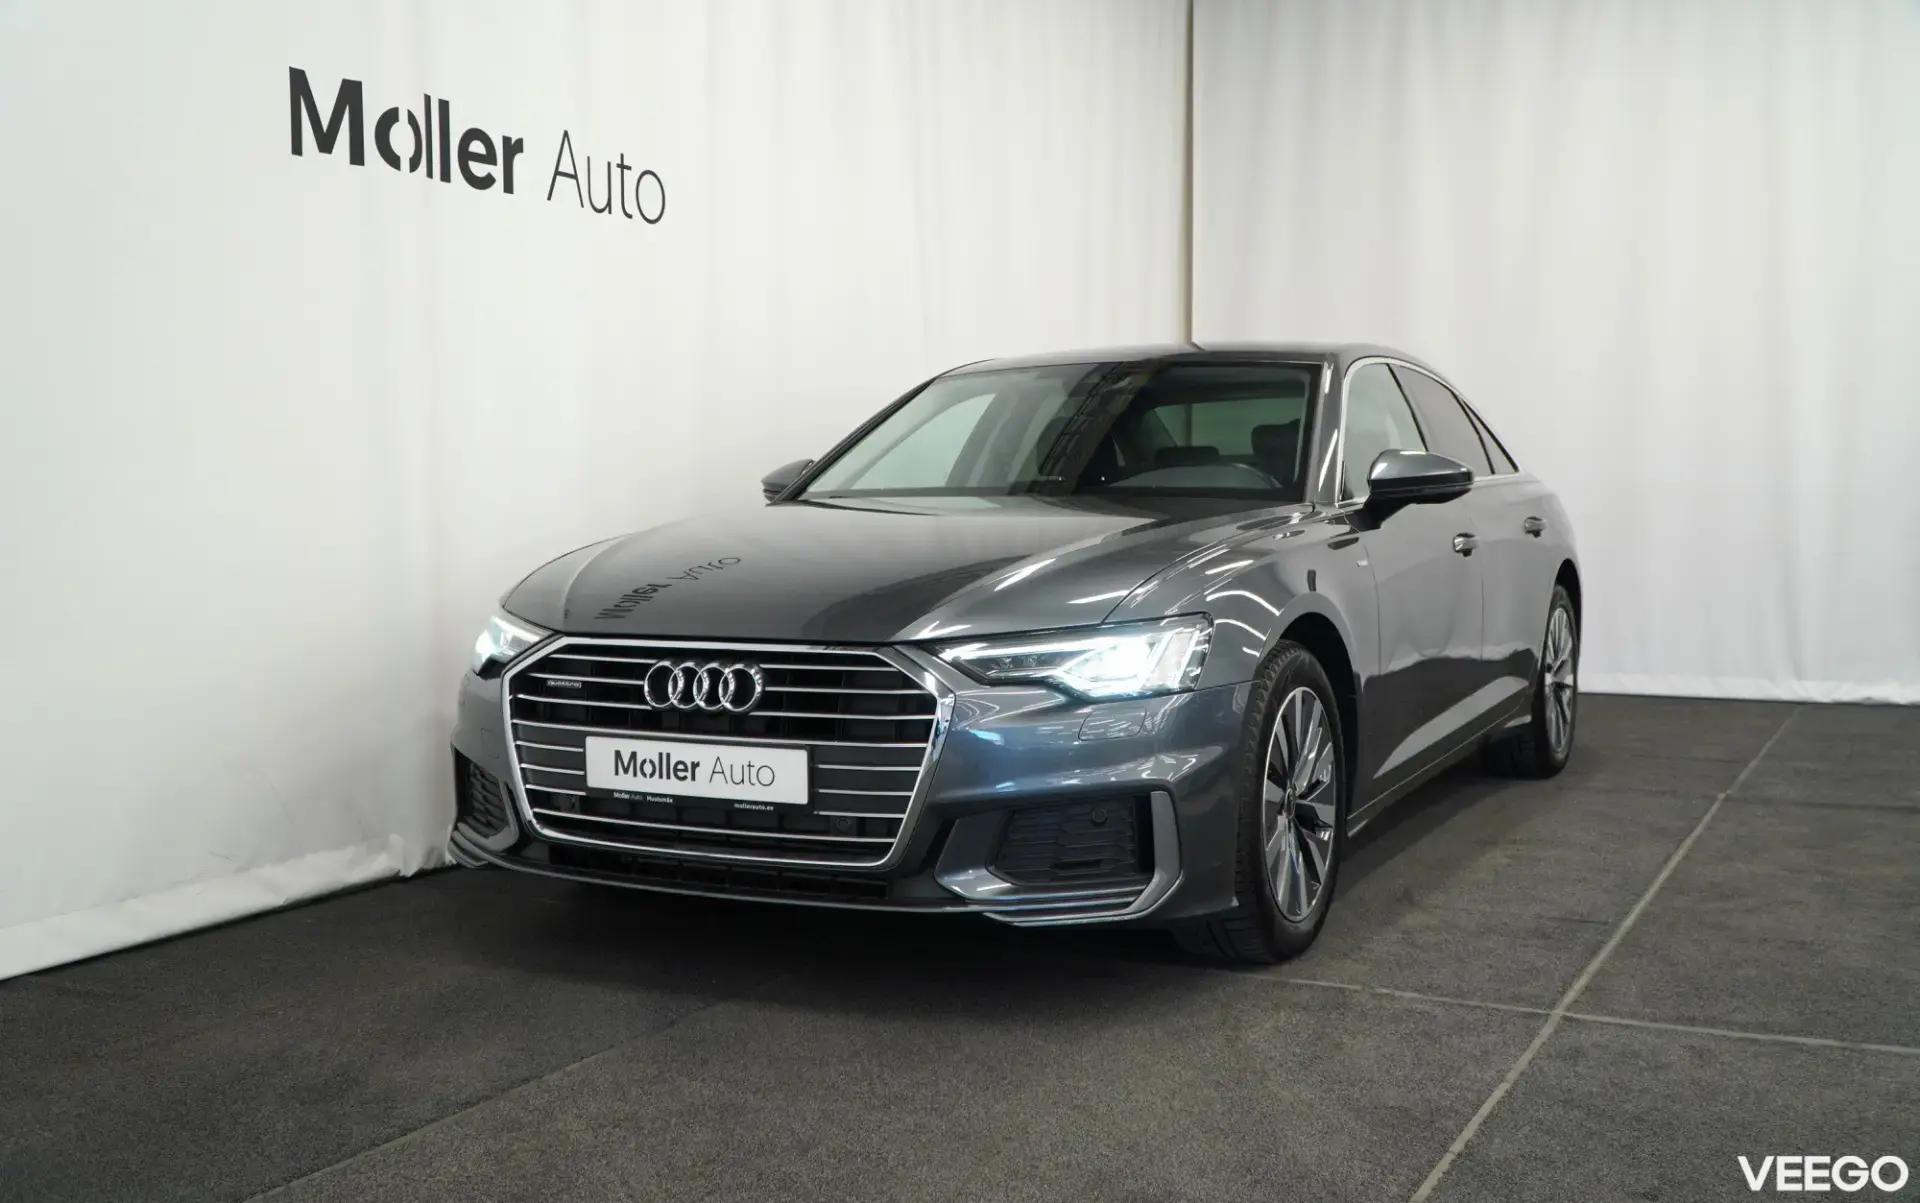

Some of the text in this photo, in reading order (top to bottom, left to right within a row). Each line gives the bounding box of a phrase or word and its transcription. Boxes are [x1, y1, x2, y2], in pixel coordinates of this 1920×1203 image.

[289, 66, 666, 225] Moller Auto
[613, 749, 775, 787] Moller Auto
